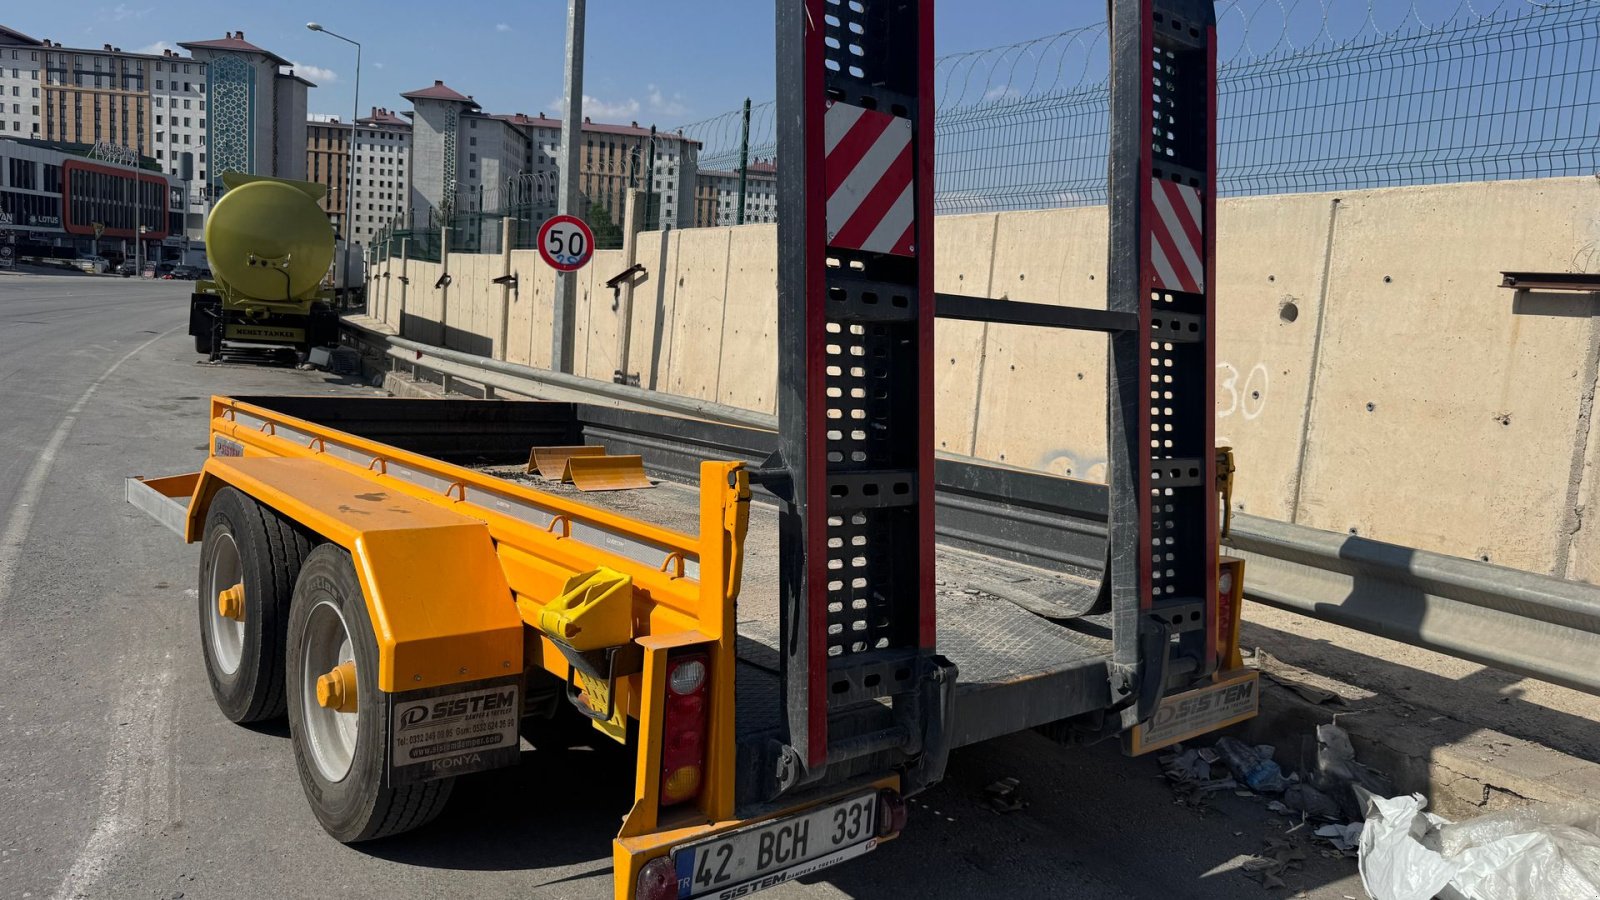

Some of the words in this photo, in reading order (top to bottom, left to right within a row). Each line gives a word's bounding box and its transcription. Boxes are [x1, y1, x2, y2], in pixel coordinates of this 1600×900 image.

[38, 215, 59, 224] LOTUS
[550, 230, 583, 256] 50
[431, 753, 481, 771] KONYA
[695, 843, 733, 887] 42
[757, 819, 809, 870] BCH
[832, 799, 873, 845] 331
